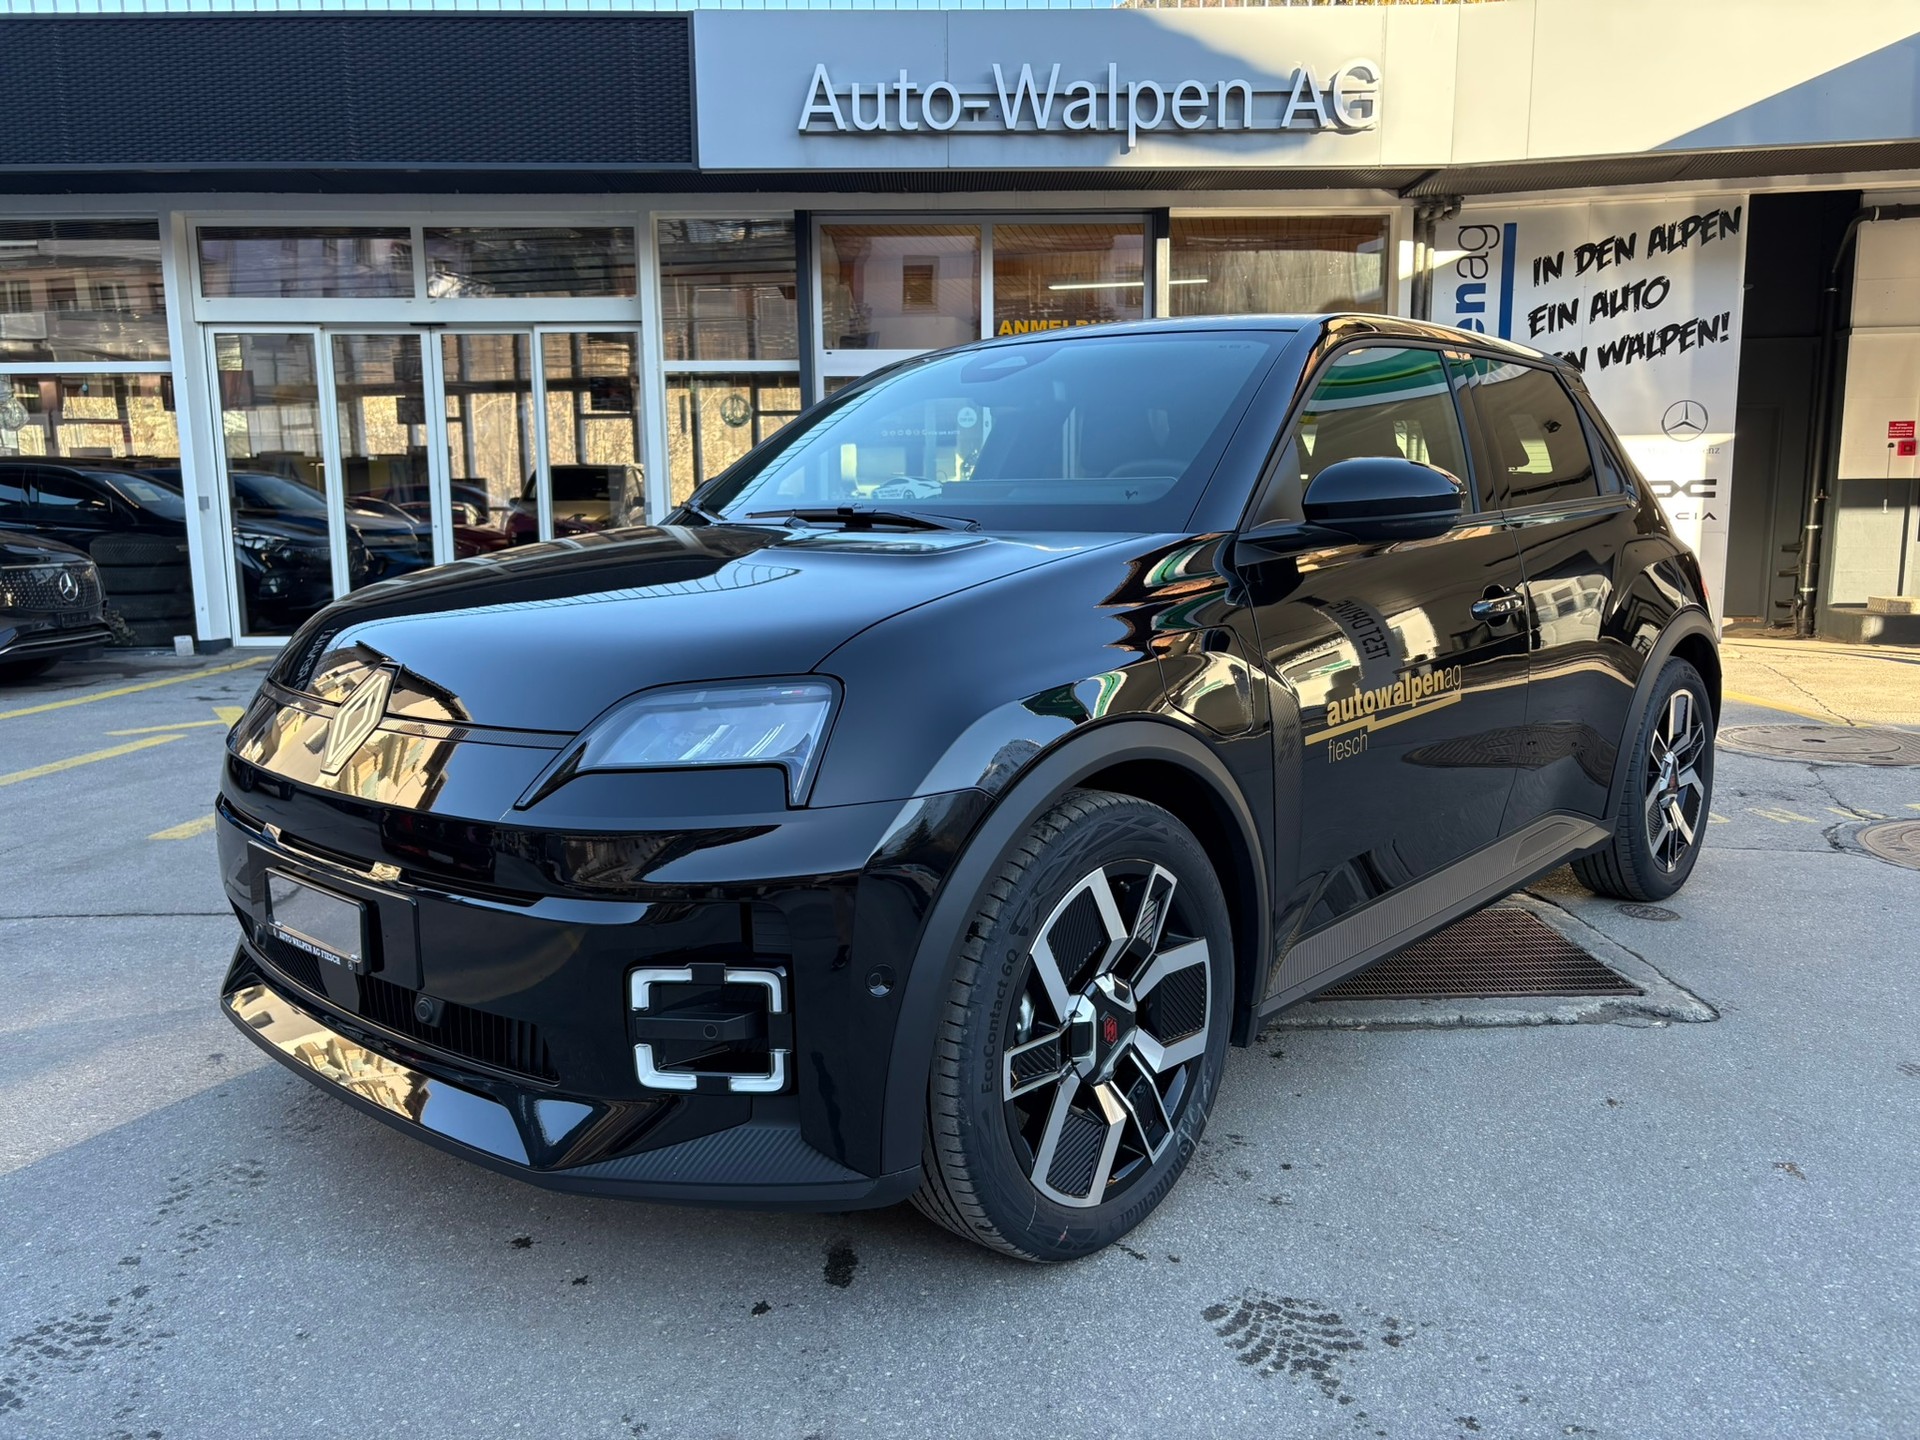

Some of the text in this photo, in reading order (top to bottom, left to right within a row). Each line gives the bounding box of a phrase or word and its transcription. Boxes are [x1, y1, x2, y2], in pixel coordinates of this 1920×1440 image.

[798, 57, 1382, 148] Auto-Walpen AG
[1533, 206, 1742, 287] IN DEN ALPEN
[1528, 275, 1671, 340] EIN AUTO
[1597, 311, 1731, 371] WALPEN!
[1328, 730, 1368, 763] fiesch
[982, 980, 1009, 1094] EcoContact
